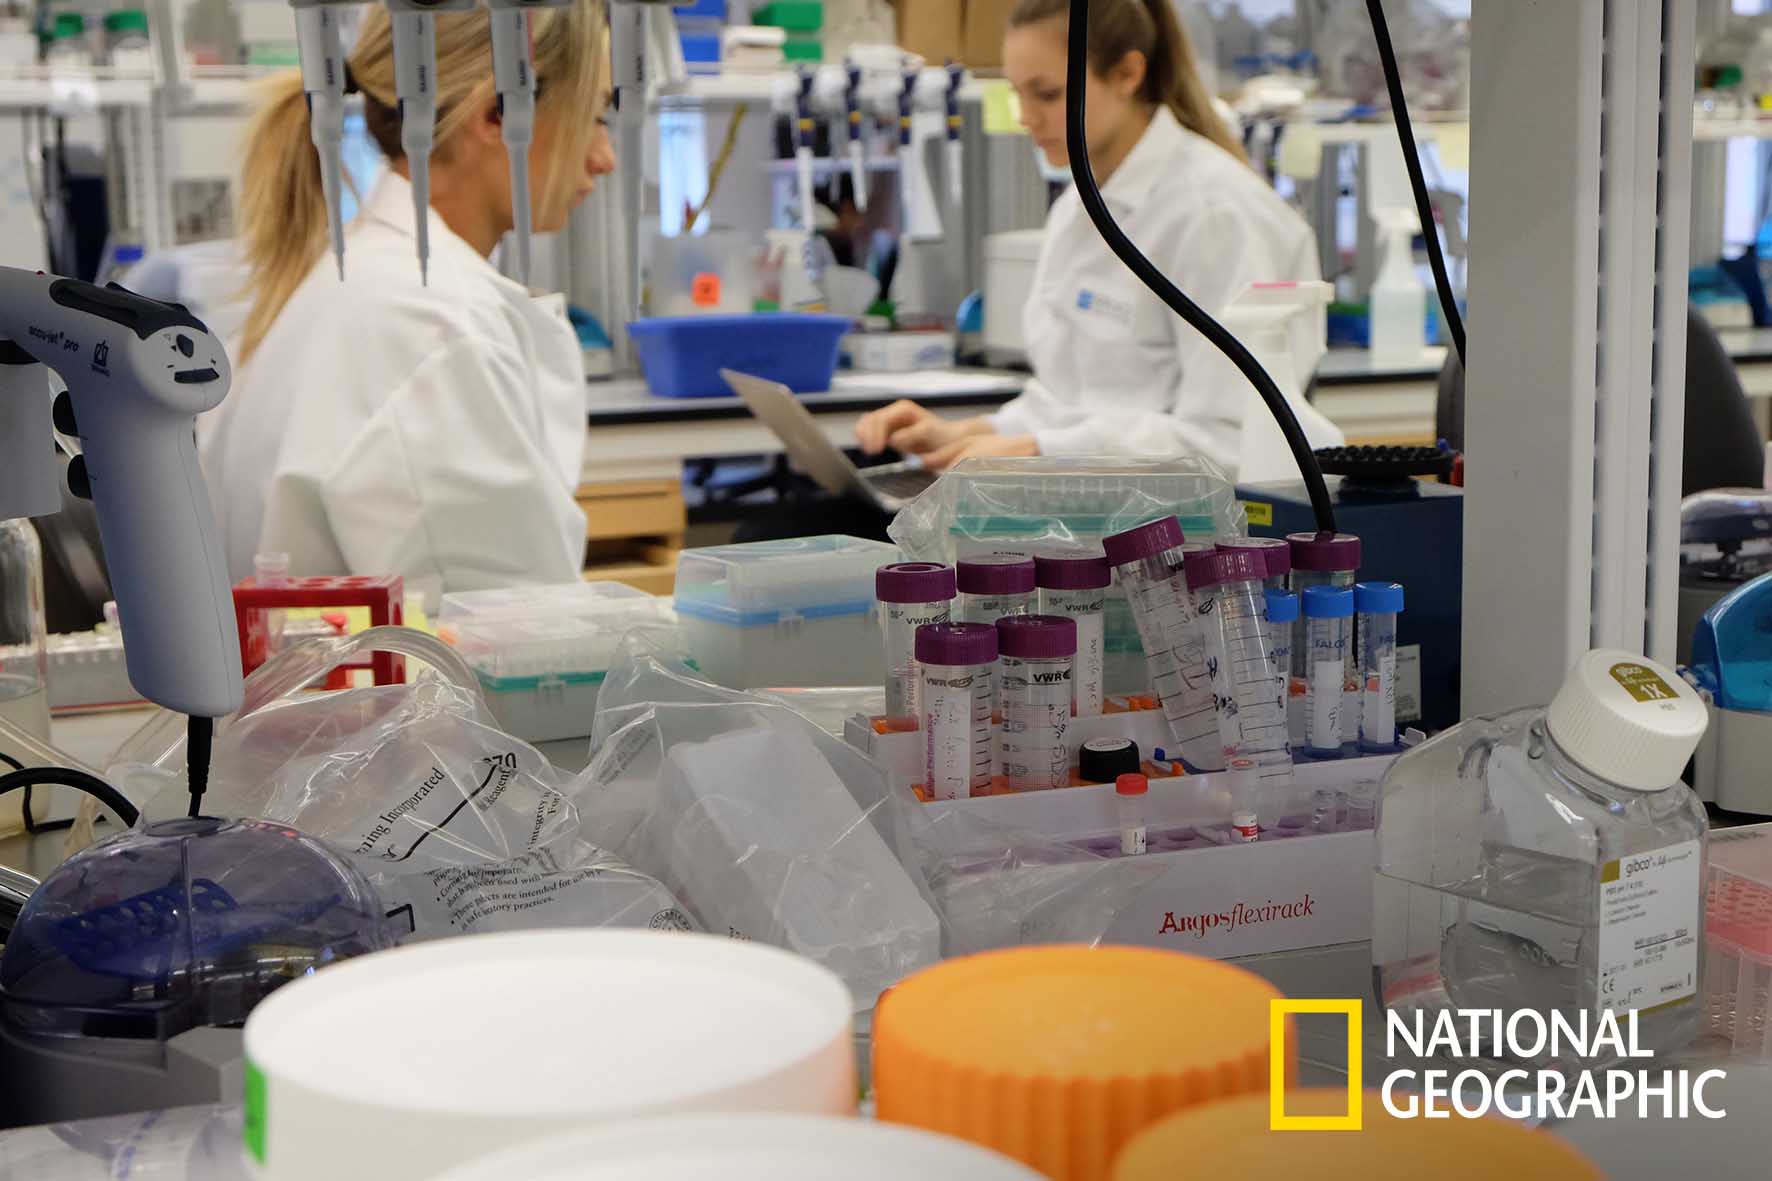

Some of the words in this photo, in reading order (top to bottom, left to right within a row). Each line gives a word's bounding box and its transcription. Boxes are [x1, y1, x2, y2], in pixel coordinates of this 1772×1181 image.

[63, 340, 80, 353] pro
[1065, 604, 1089, 612] VWR
[906, 617, 931, 625] VWR
[1315, 639, 1344, 649] FALCO
[926, 677, 947, 688] VWR
[1033, 673, 1063, 684] VWR
[1640, 682, 1669, 700] 1X
[379, 766, 446, 825] Incorporated
[519, 885, 557, 899] intended
